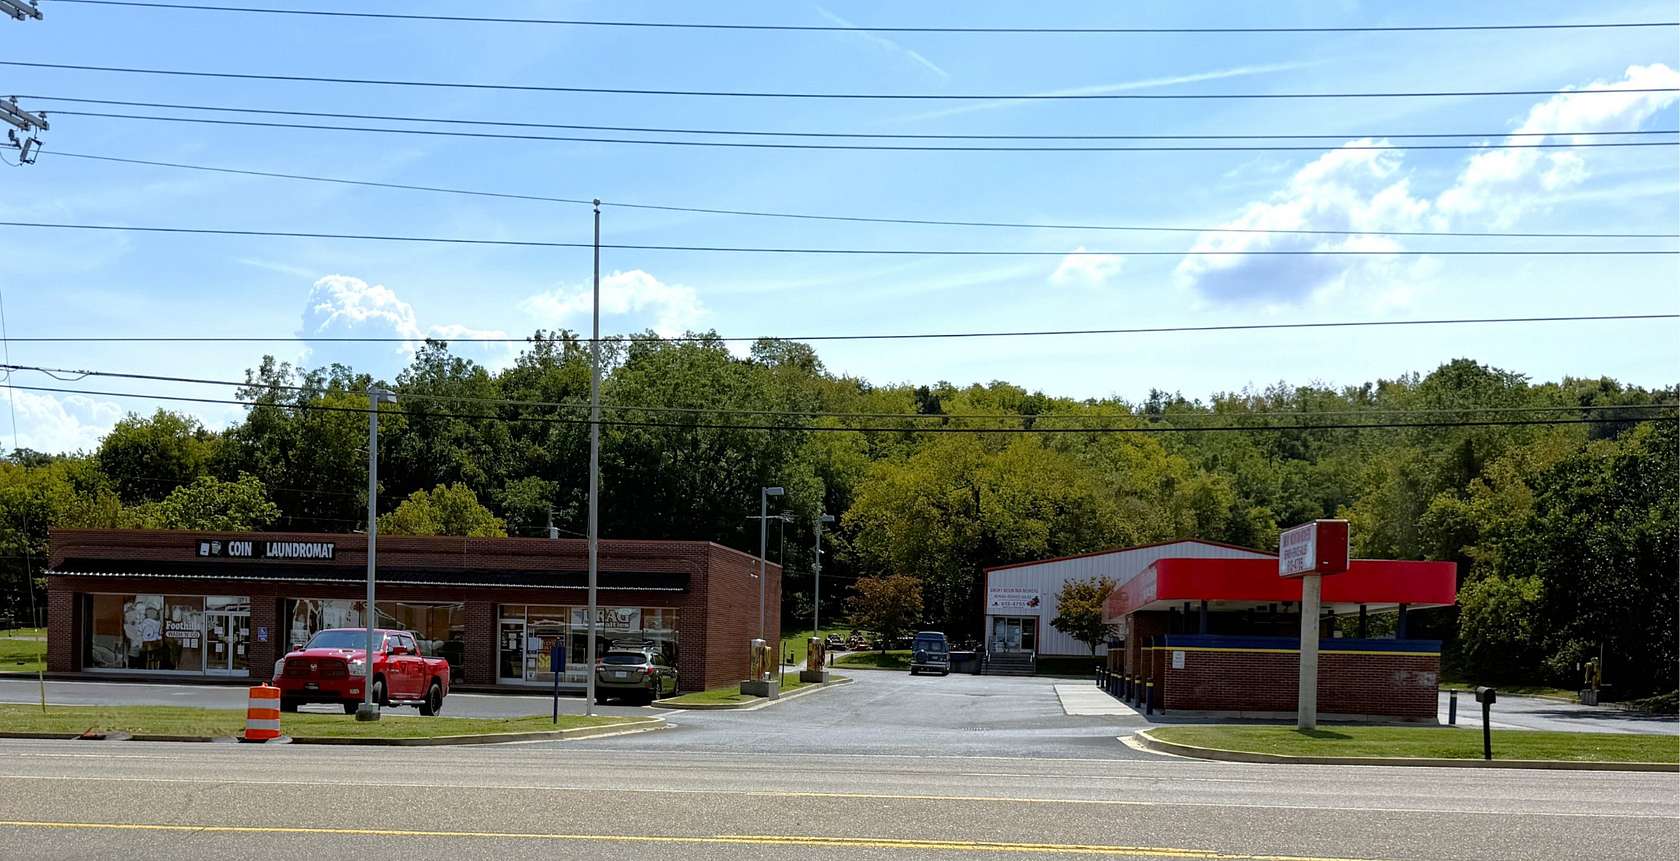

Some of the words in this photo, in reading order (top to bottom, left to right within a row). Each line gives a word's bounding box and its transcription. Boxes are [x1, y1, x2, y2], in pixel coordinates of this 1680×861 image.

[228, 541, 252, 556] COIN
[266, 542, 335, 558] LAUNDROMAT
[166, 620, 201, 630] Foothills
